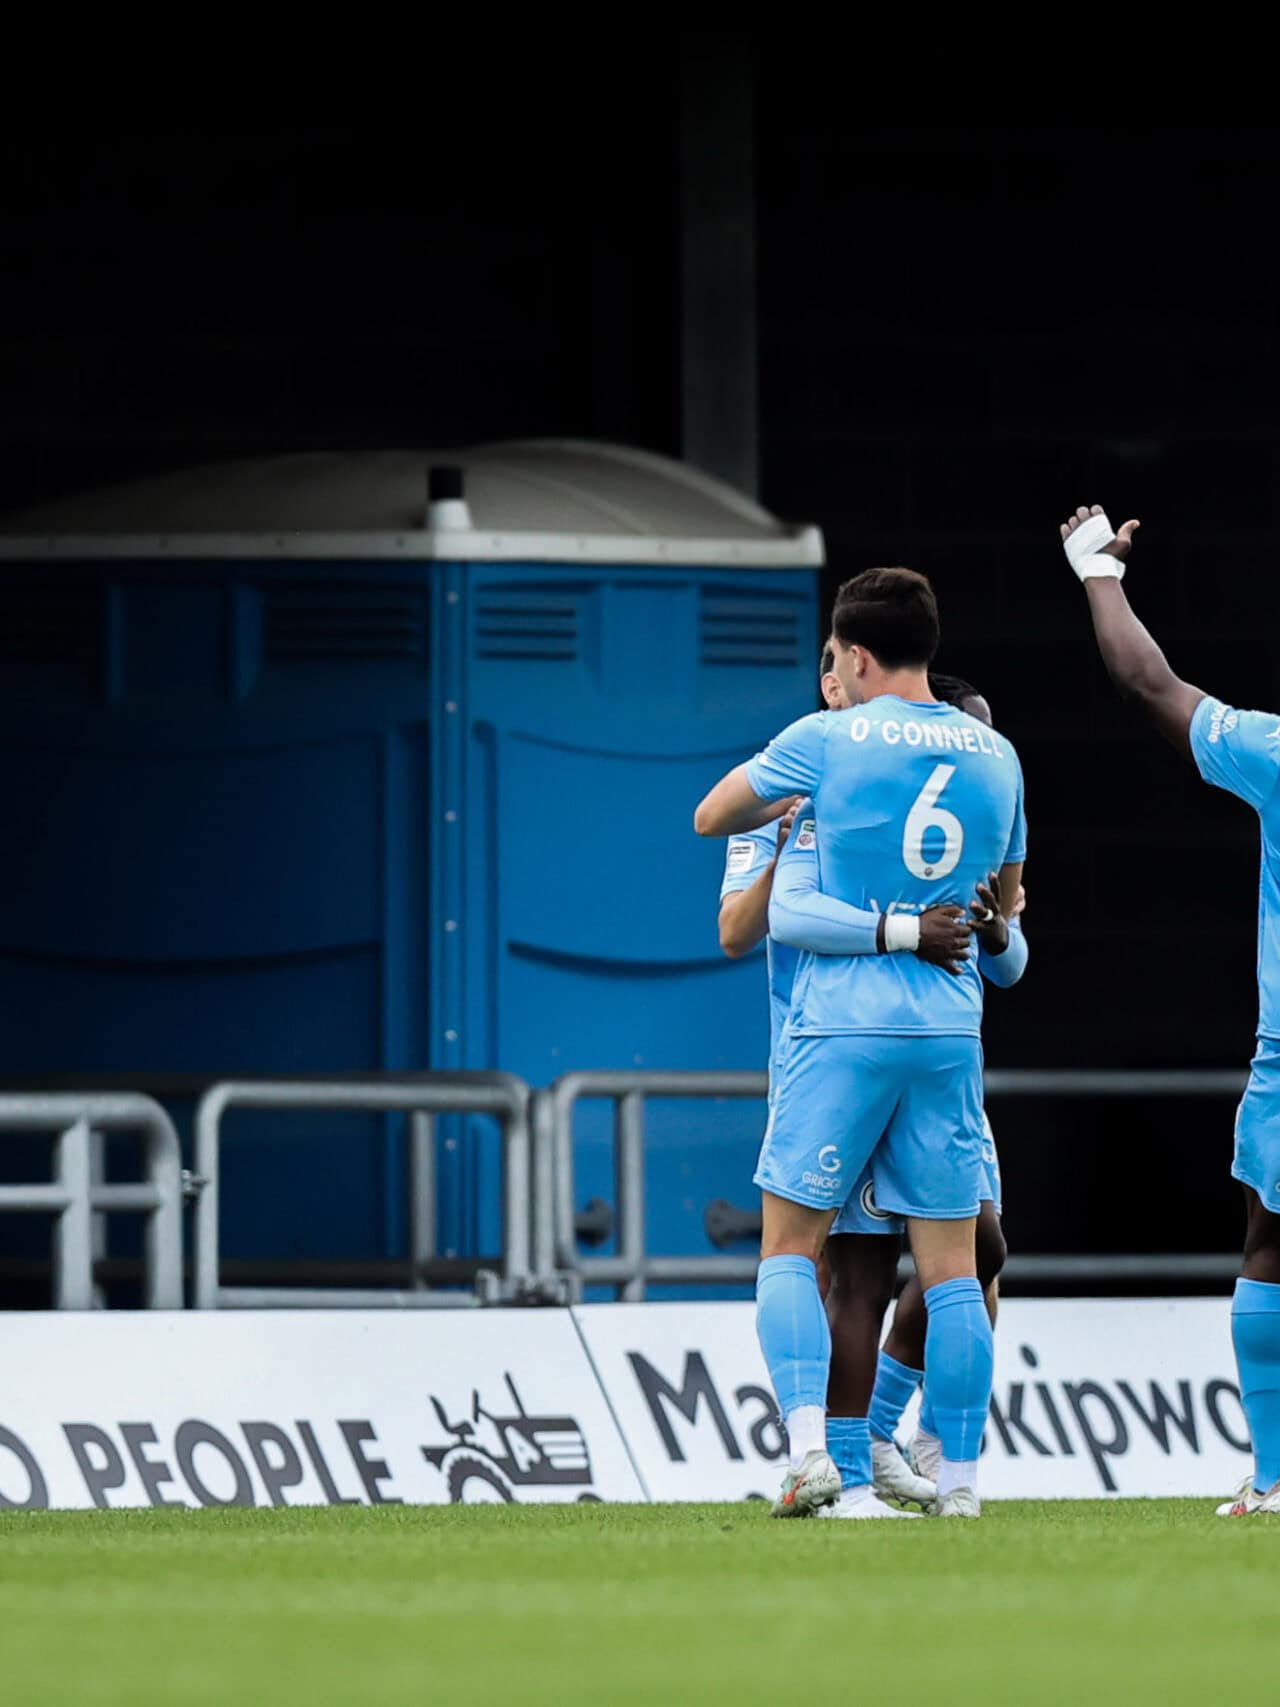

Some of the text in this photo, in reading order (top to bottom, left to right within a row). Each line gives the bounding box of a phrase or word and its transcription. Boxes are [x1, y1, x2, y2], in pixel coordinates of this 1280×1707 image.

[850, 716, 1004, 759] O'CONNELL
[902, 763, 964, 881] 6
[802, 1171, 840, 1189] GRIGG
[61, 1419, 403, 1508] PEOPLE
